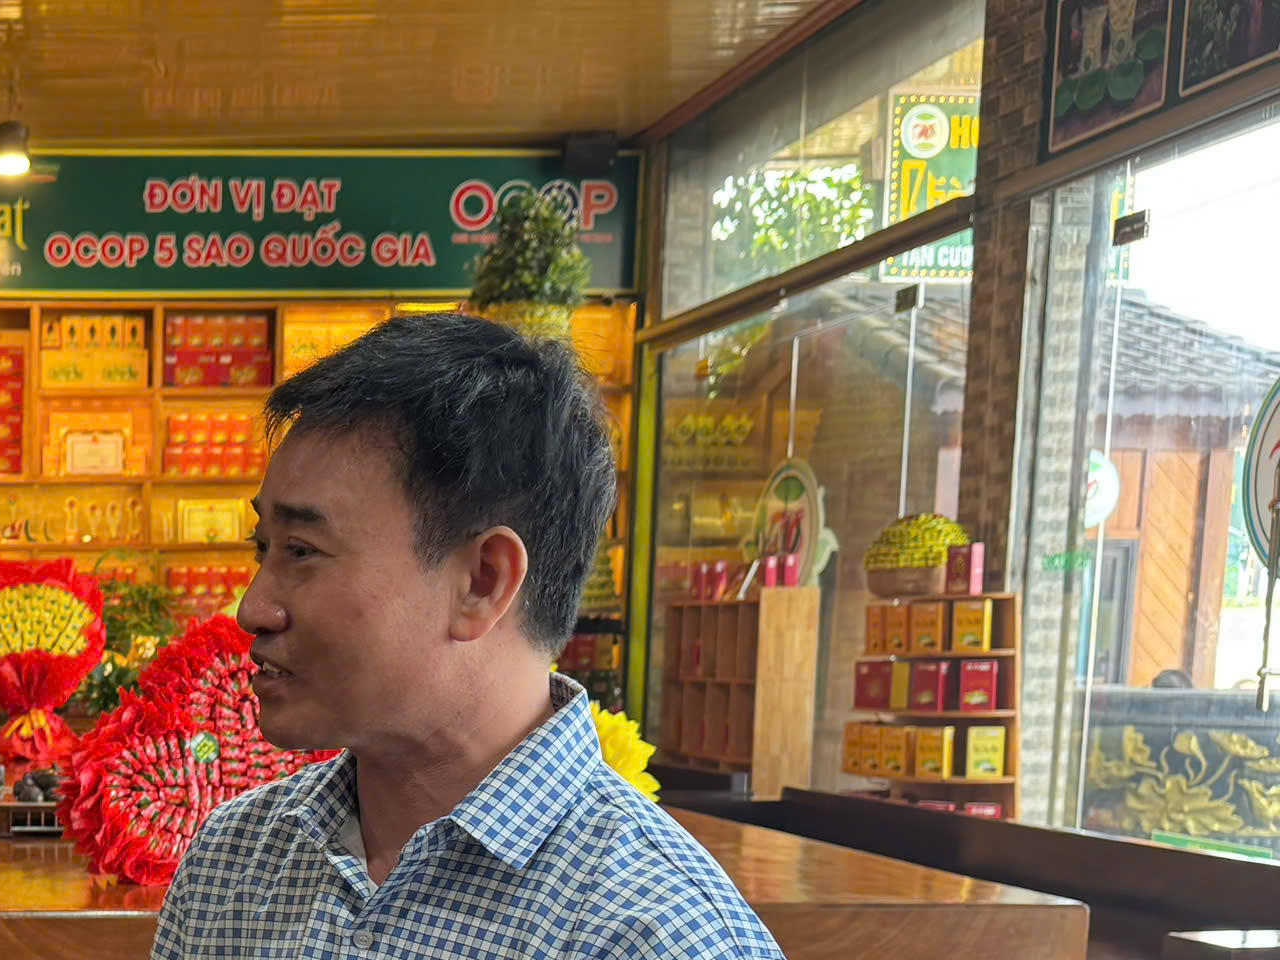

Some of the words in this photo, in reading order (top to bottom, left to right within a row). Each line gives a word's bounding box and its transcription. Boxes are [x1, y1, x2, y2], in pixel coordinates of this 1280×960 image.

[143, 173, 223, 213] ĐƠN
[228, 178, 266, 221] VỊ
[271, 178, 342, 222] ĐẠT
[44, 232, 149, 268] OCOP
[153, 232, 178, 268] 5
[182, 232, 254, 268] SAO
[260, 219, 366, 268] QUỐC
[371, 232, 436, 267] GIA
